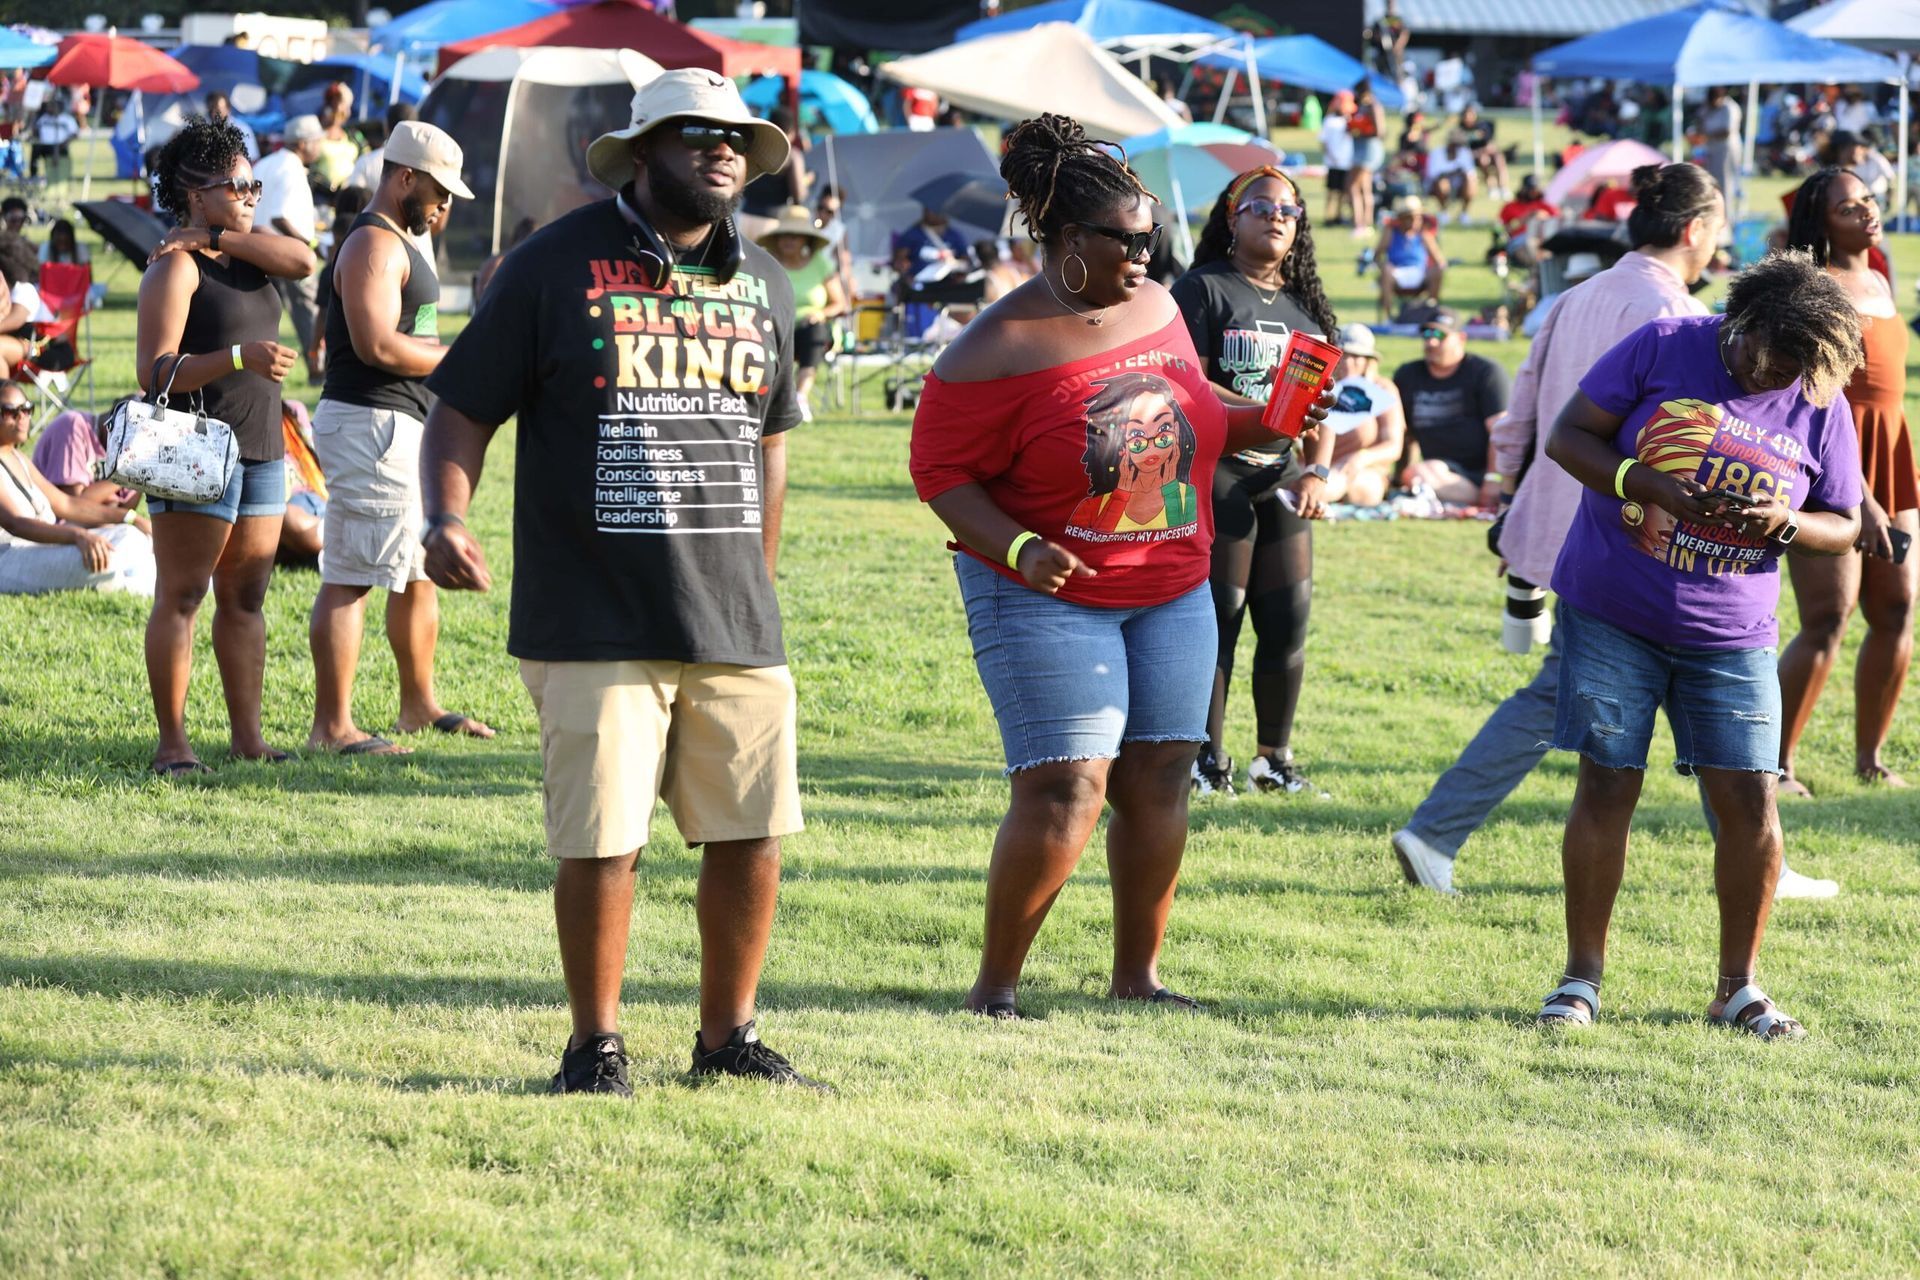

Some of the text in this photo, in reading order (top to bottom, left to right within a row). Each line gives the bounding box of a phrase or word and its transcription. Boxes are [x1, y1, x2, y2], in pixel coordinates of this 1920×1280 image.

[614, 334, 765, 392] KING
[617, 392, 703, 412] Nutrition
[599, 423, 658, 438] Melanin
[1721, 415, 1802, 461] JULY 4TH
[597, 445, 683, 461] Foolishness
[595, 467, 706, 482] Consciousness
[1705, 456, 1793, 509] 1865
[595, 488, 681, 505] Intelligence
[595, 509, 678, 526] Leadership
[1064, 523, 1198, 543] REMEMBERING MY ANCESTORS
[1676, 532, 1766, 560] WEREN'T FREE
[1669, 545, 1697, 572] IN
